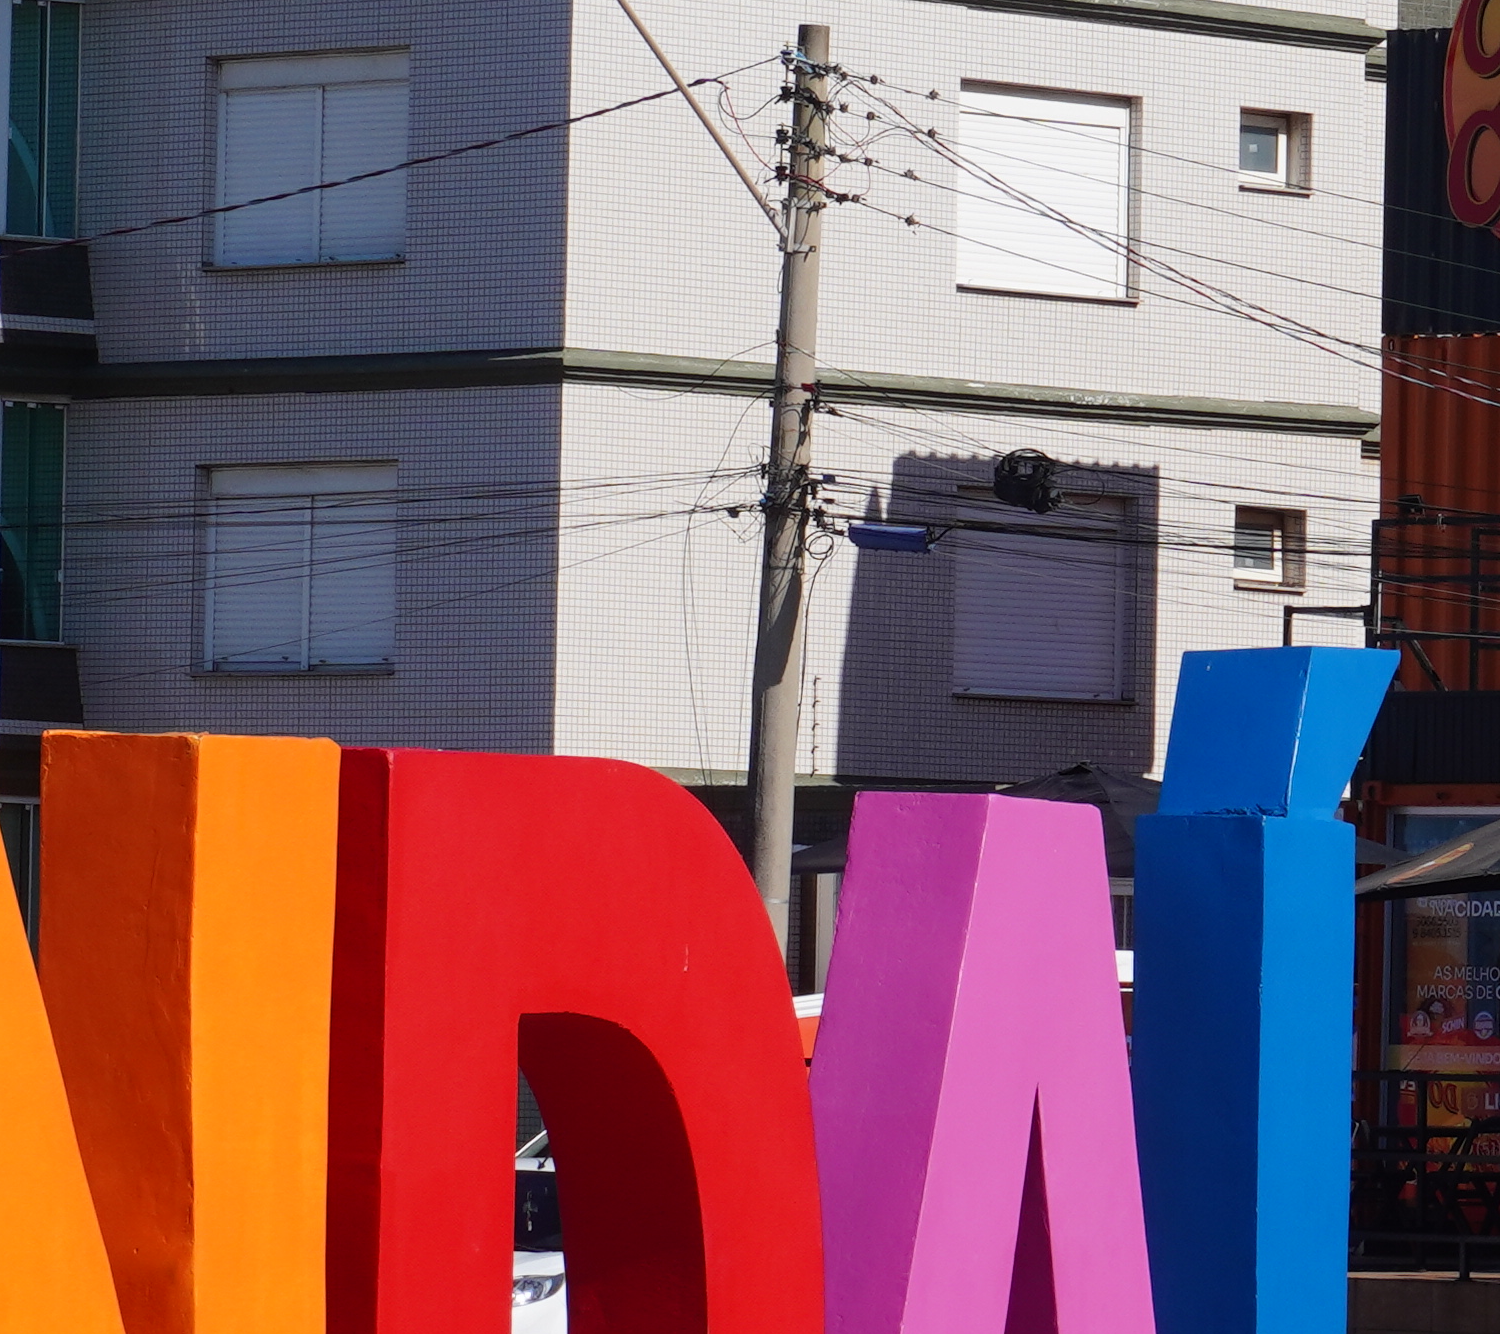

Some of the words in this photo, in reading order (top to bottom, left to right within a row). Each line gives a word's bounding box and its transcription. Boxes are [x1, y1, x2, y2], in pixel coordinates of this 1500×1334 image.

[1433, 966, 1452, 981] AS
[1416, 984, 1473, 999] MARCAS
[1476, 985, 1493, 999] DE
